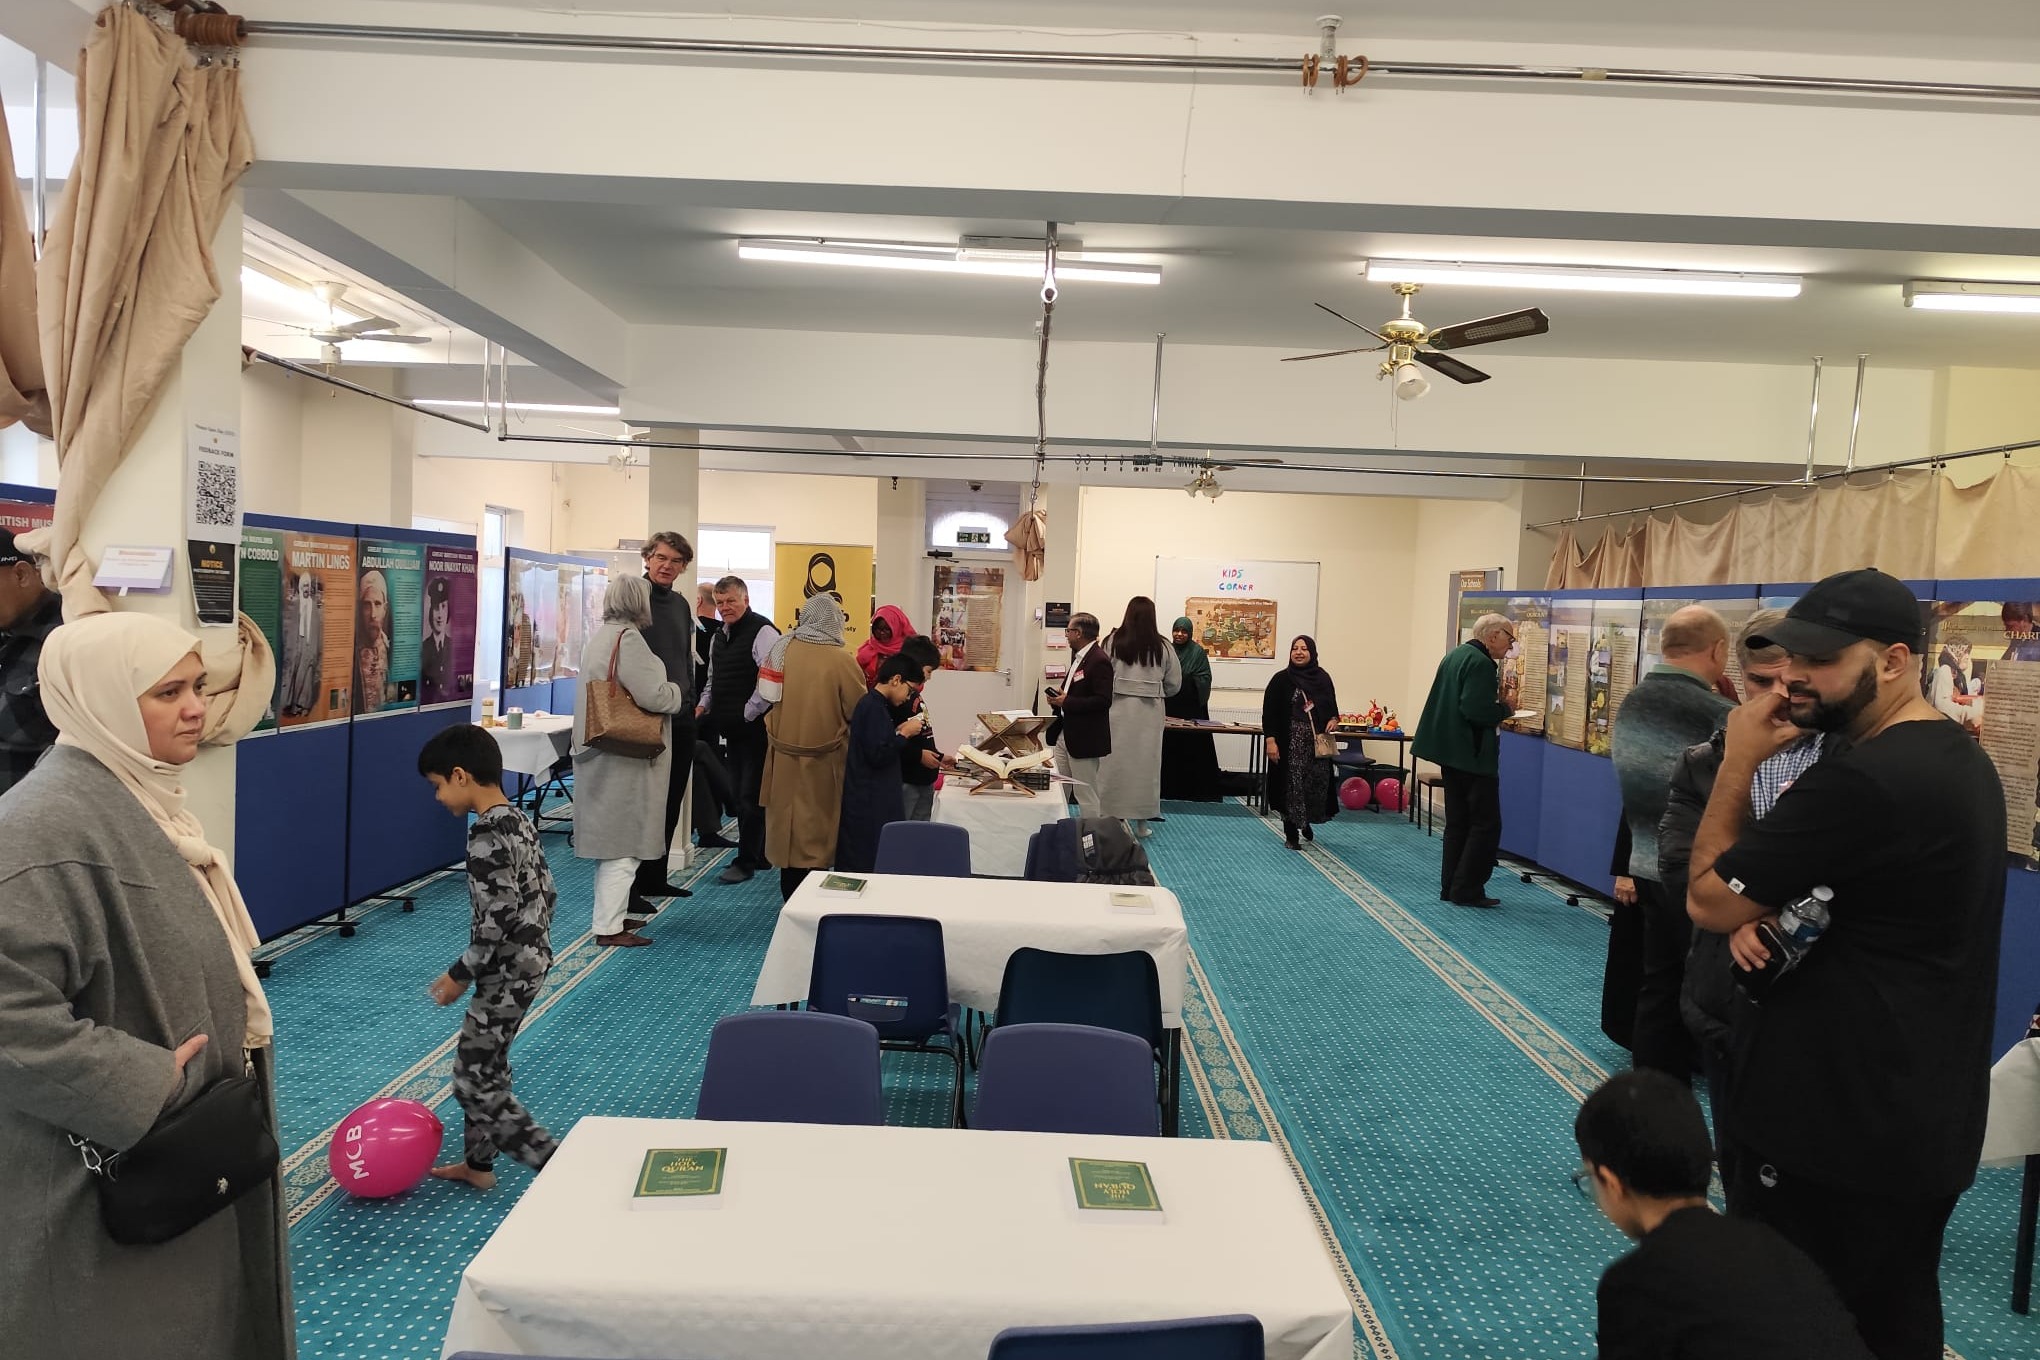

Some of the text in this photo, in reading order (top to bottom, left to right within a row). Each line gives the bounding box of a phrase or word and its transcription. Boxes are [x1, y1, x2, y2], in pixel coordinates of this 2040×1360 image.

[247, 547, 279, 561] COBBOLD
[292, 551, 350, 570] MARTIN LINGS
[362, 556, 394, 568] ABDULLAH
[428, 560, 444, 572] NOOR
[462, 562, 475, 574] KHAN
[1222, 569, 1244, 579] KIDS
[1219, 583, 1254, 591] CORNER
[2003, 630, 2040, 640] CHARI
[346, 1125, 370, 1180] MCB
